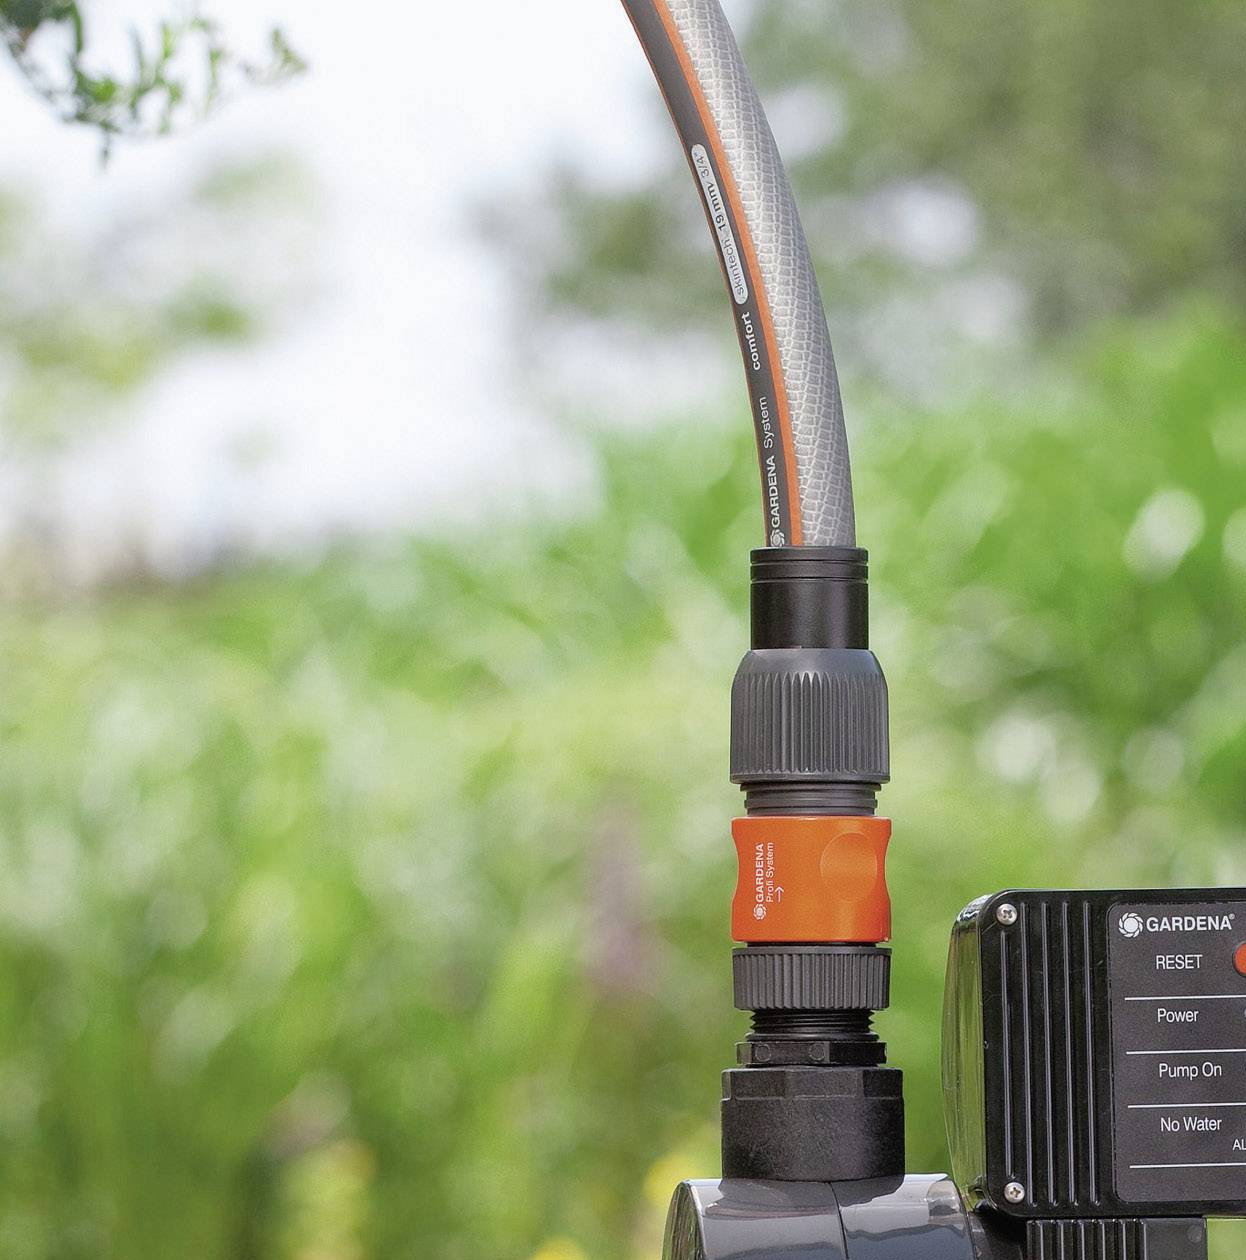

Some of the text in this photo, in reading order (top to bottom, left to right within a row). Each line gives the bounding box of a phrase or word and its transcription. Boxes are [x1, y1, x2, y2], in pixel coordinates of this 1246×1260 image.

[716, 214, 727, 231] 19
[741, 312, 780, 528] GARDENA System comfort
[755, 843, 765, 903] GARDENA
[766, 842, 775, 903] Profi System
[1156, 954, 1203, 970] RESET
[1157, 1008, 1199, 1023] Power
[1159, 1061, 1222, 1081] Pump On
[1160, 1116, 1222, 1132] No Water
